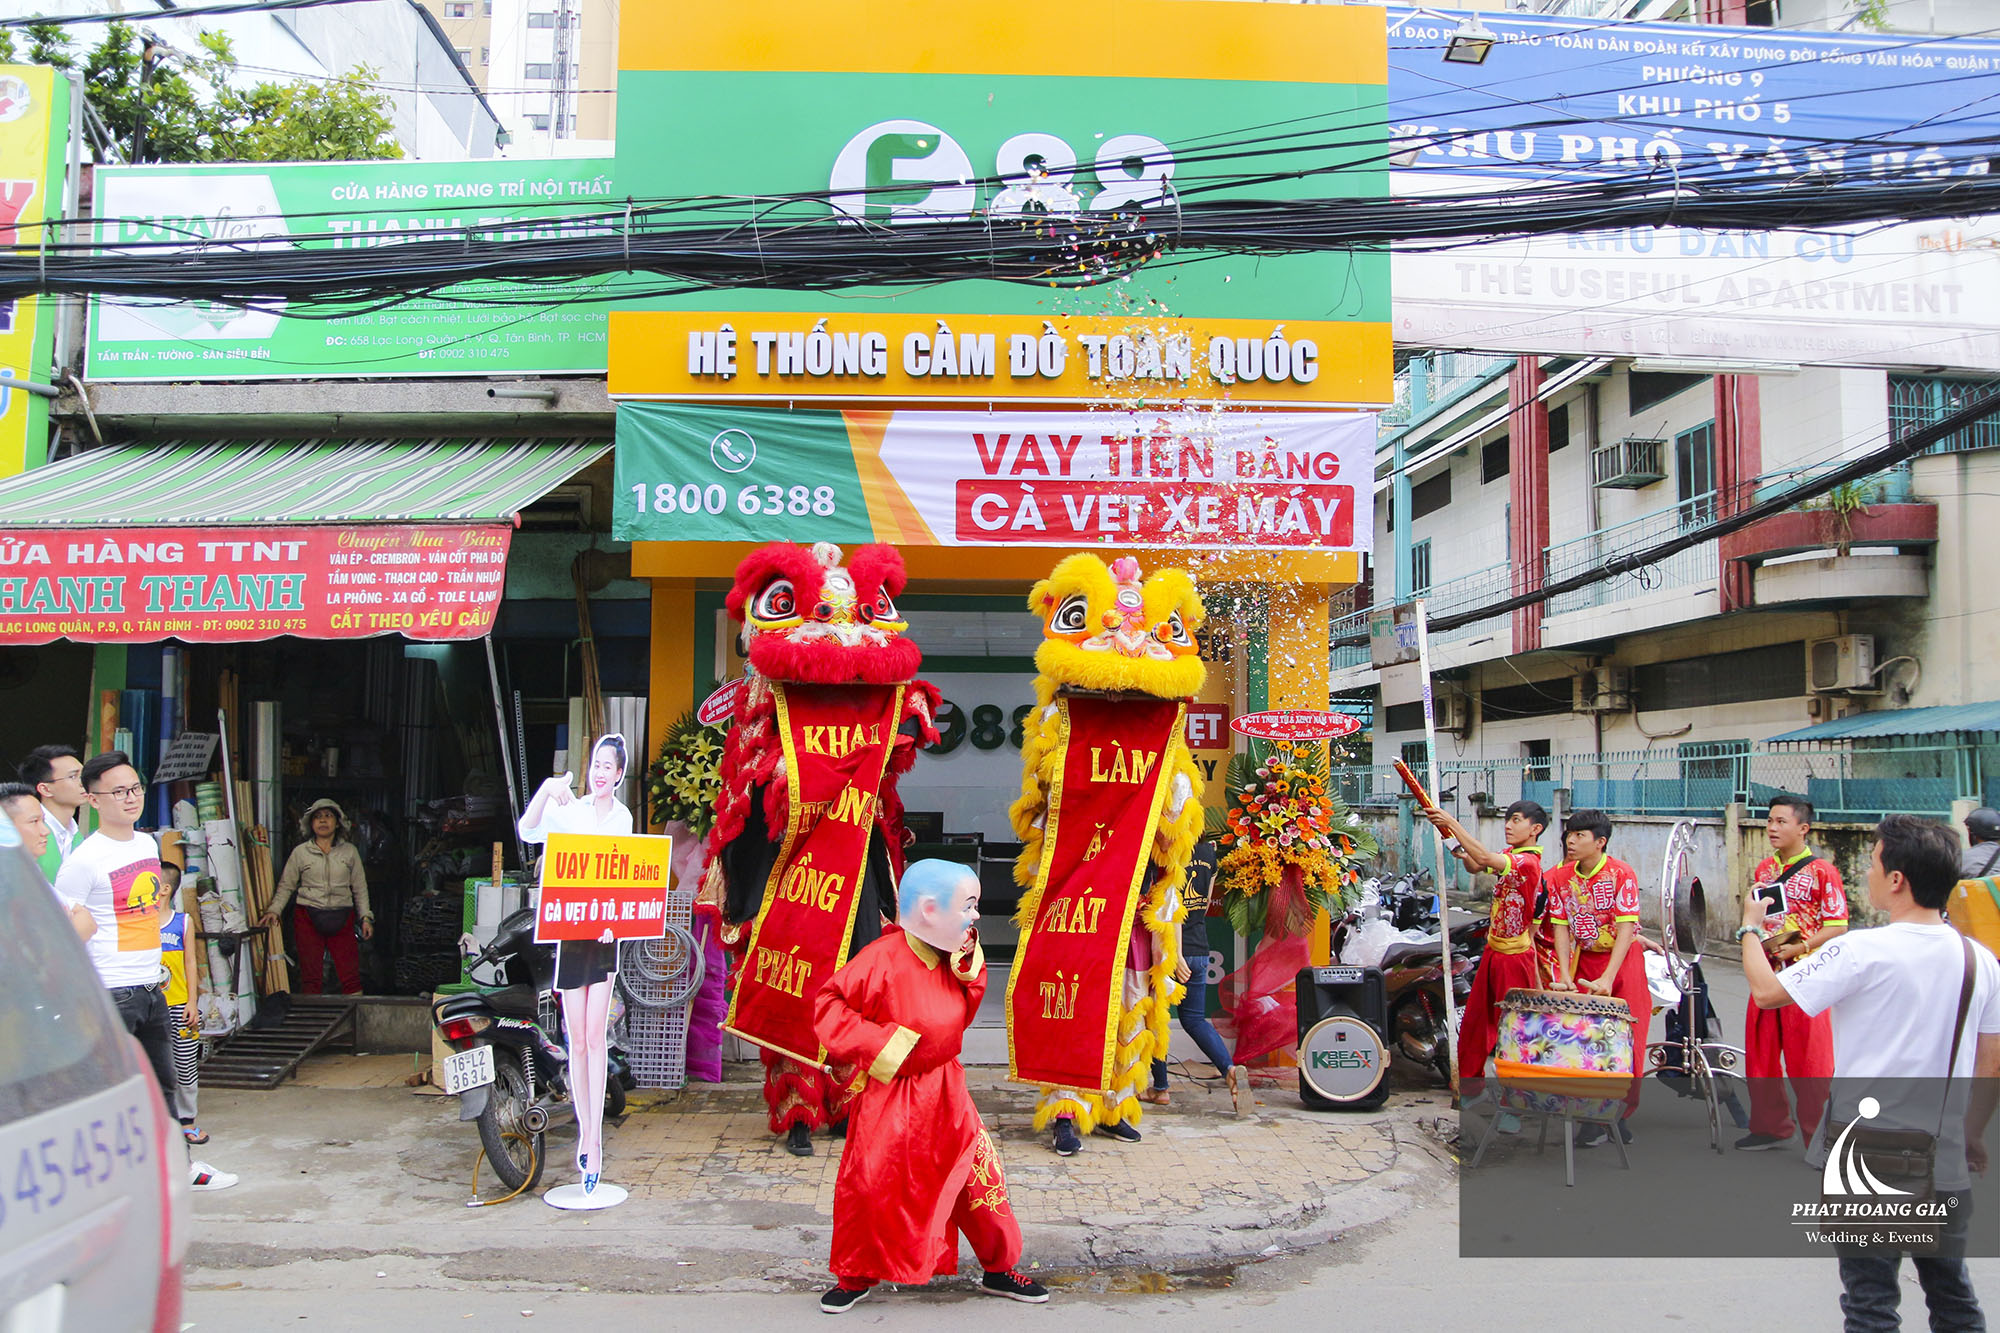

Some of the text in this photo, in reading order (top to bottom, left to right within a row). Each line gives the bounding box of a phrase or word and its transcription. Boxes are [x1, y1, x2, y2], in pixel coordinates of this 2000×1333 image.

[1404, 27, 1439, 42] ĐẠO
[1598, 38, 1629, 52] DÂN
[1633, 40, 1677, 55] ĐOÀN
[1682, 40, 1706, 56] KẾT
[1710, 43, 1740, 58] XÂY
[1744, 47, 1786, 63] DỰNG
[1790, 48, 1817, 62] ĐỜI
[1821, 48, 1863, 64] SỐNG
[1866, 51, 1897, 66] VĂN
[1946, 57, 1990, 72] QUẬN
[1642, 64, 1764, 88] PHƯỜNG 9
[1618, 94, 1791, 124] KHU PHỐ 5
[1399, 125, 1537, 161] KHU
[1558, 127, 1684, 168] PHỐ
[331, 174, 612, 200] CỬA HÀNG TRANG TRÍ NỘI THẤT
[1456, 262, 1964, 314] THE USEFUL APARTMENT
[584, 312, 606, 322] che
[326, 336, 348, 346] ĐC:
[350, 336, 370, 346] 658
[372, 336, 392, 346] Lạc
[396, 335, 423, 346] Long
[506, 332, 525, 342] Tân
[578, 332, 606, 342] HCM
[440, 348, 465, 358] 0902
[468, 348, 488, 358] 310
[490, 348, 510, 358] 475
[688, 324, 738, 381] HỆ
[752, 318, 888, 377] THỐNG
[903, 320, 996, 378] CẦM
[1009, 320, 1066, 378] ĐỒ
[1209, 324, 1319, 386] QUỐC
[158, 348, 194, 360] TƯỜNG
[972, 417, 1340, 481] VAY TIỀN BẰNG
[631, 483, 836, 517] 1800 6388
[970, 482, 1046, 532] CÀ
[1159, 494, 1221, 534] XE
[1237, 486, 1342, 536] MÁY
[67, 538, 184, 564] HÀNG
[197, 541, 308, 562] TTNT
[330, 552, 348, 566] VÁN
[350, 552, 362, 565] ÉP
[370, 552, 420, 564] CREMBRON
[428, 550, 447, 564] VÁN
[450, 547, 468, 564] CỐT
[470, 552, 489, 564] PHA
[351, 572, 376, 584] VONG
[385, 572, 417, 586] THẠCH
[418, 572, 438, 584] CAO
[476, 570, 501, 585] NHỰA
[0, 573, 307, 614] HANH THANH
[326, 590, 498, 604] LA PHÔNG XA TOLE LẠNH
[26, 622, 56, 634] LONG
[122, 620, 134, 634] Q.
[137, 618, 162, 632] TÂN
[164, 618, 192, 632] BÌNH
[203, 618, 222, 630] ĐT:
[225, 618, 254, 630] 0902
[258, 618, 280, 630] 310
[284, 618, 307, 630] 475
[330, 606, 490, 629] CẮT THEO YÊU CẦU
[803, 722, 882, 758] KHAI
[1184, 713, 1222, 746] ẸT
[1090, 740, 1158, 784] LÀM
[556, 844, 660, 881] VAY TIỀN BẰNG
[544, 898, 664, 926] CÀ VẸT Ô TÔ, XE MÁY
[1039, 970, 1080, 1019] TÀI
[452, 1050, 486, 1074] 16-L2
[452, 1069, 488, 1091] 3634
